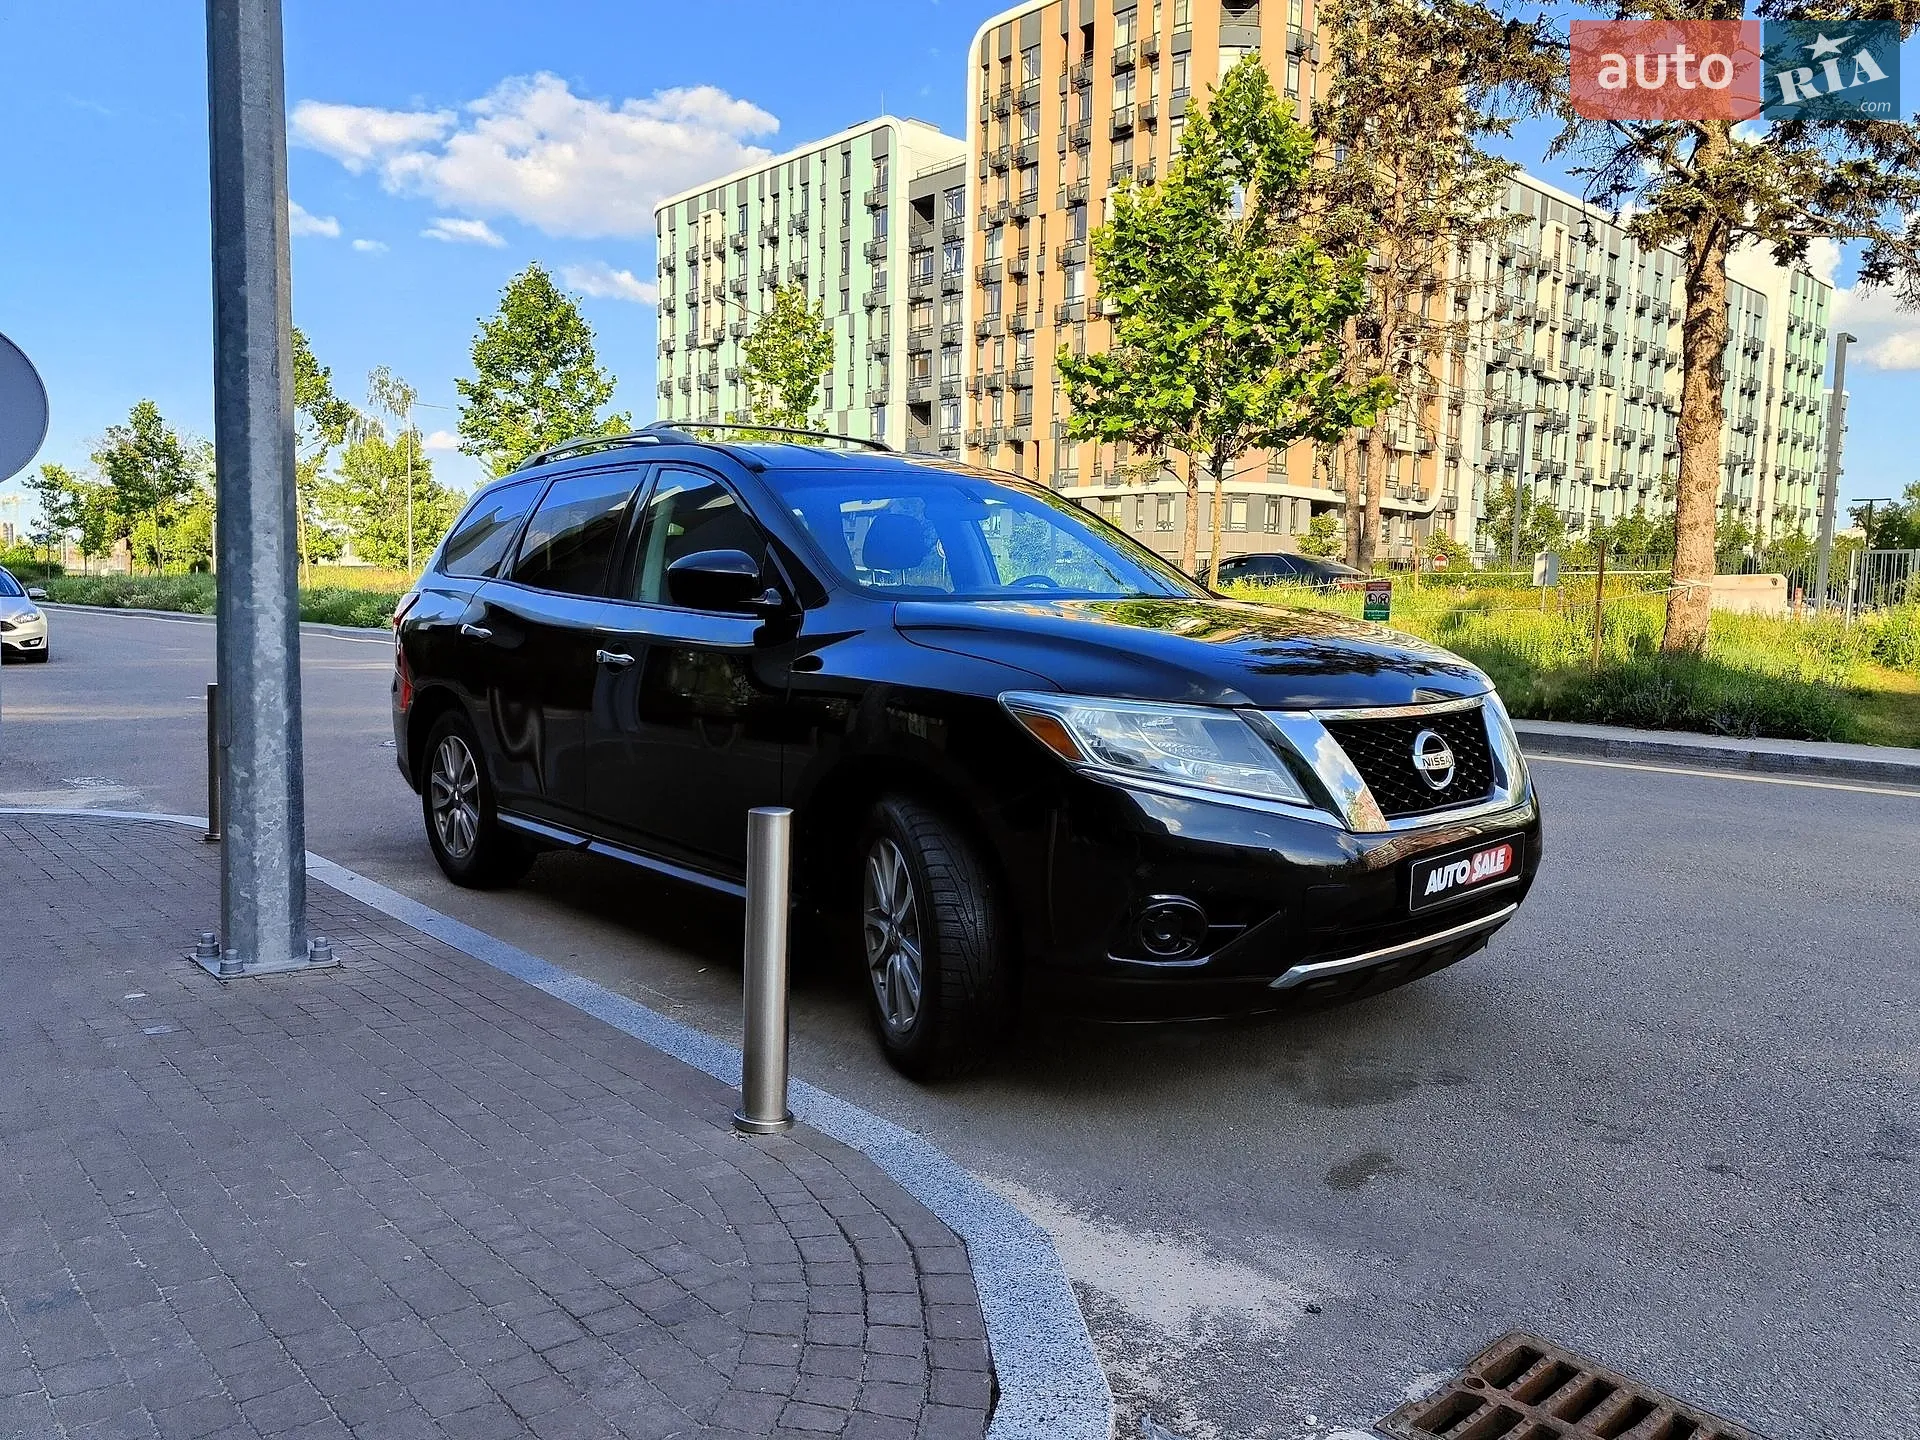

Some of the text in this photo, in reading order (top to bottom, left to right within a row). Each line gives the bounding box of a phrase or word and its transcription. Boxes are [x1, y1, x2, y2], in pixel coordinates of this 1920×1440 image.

[1422, 755, 1453, 767] NISSA
[1424, 848, 1506, 896] AUTO SALE
